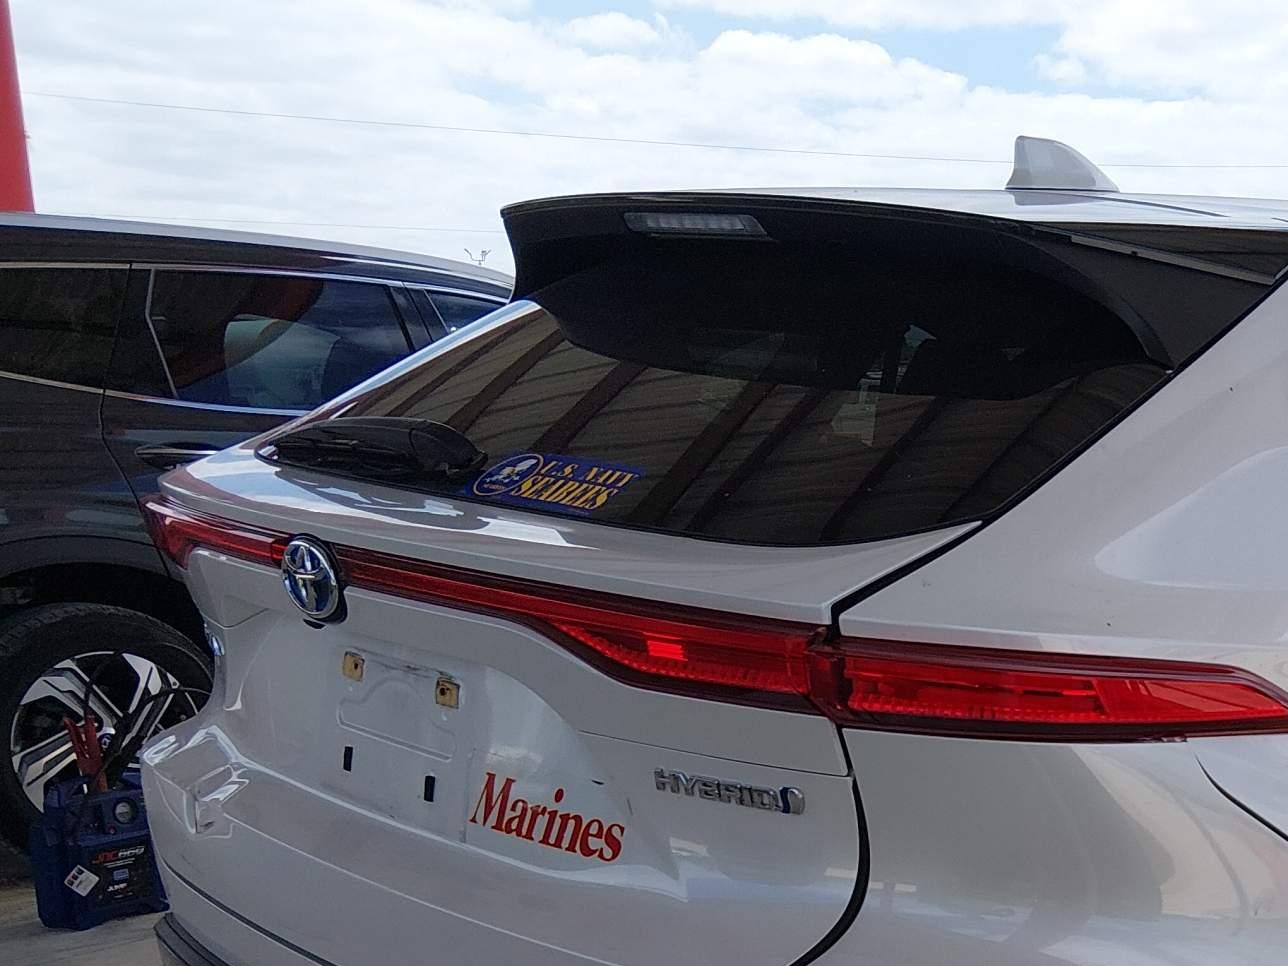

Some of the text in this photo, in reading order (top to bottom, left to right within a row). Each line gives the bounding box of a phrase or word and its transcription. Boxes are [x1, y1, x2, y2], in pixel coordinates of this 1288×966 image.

[511, 475, 619, 510] SEABEES
[654, 767, 779, 811] HYBRID
[469, 771, 625, 862] Marines
